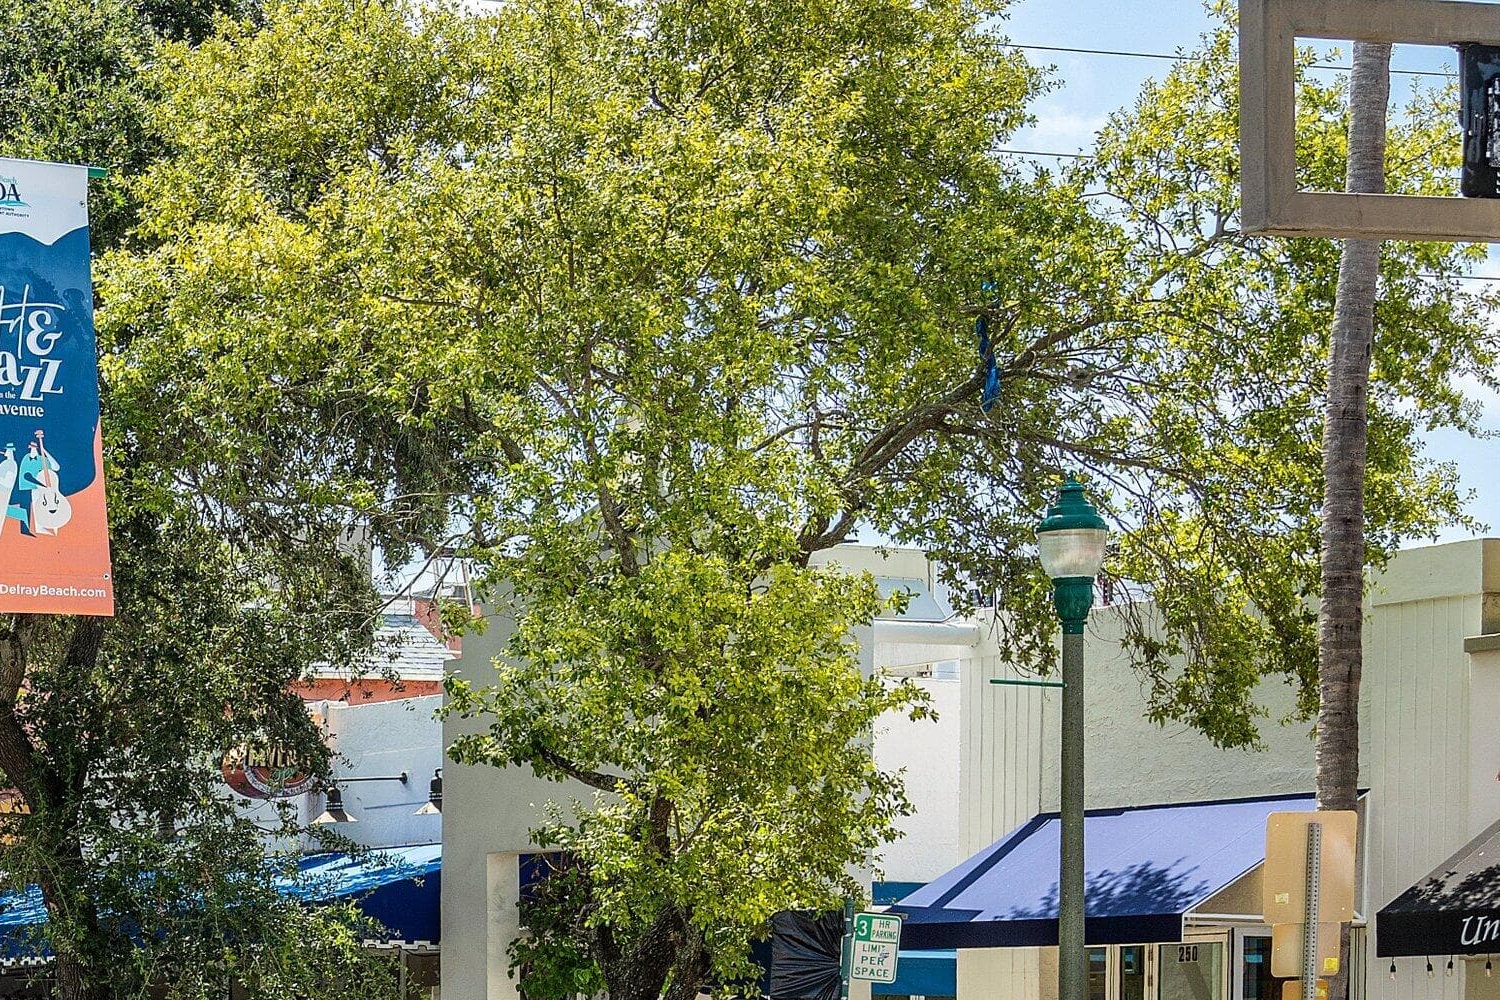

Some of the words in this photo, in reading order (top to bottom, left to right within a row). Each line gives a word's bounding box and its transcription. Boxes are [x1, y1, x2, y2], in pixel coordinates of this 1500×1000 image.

[4, 390, 17, 399] the
[857, 920, 868, 936] 3
[878, 920, 891, 929] HR
[872, 930, 897, 939] PARKING
[862, 944, 886, 953] LIMIT
[1178, 945, 1198, 963] 250
[860, 955, 885, 966] PER
[854, 966, 889, 978] SPACE
